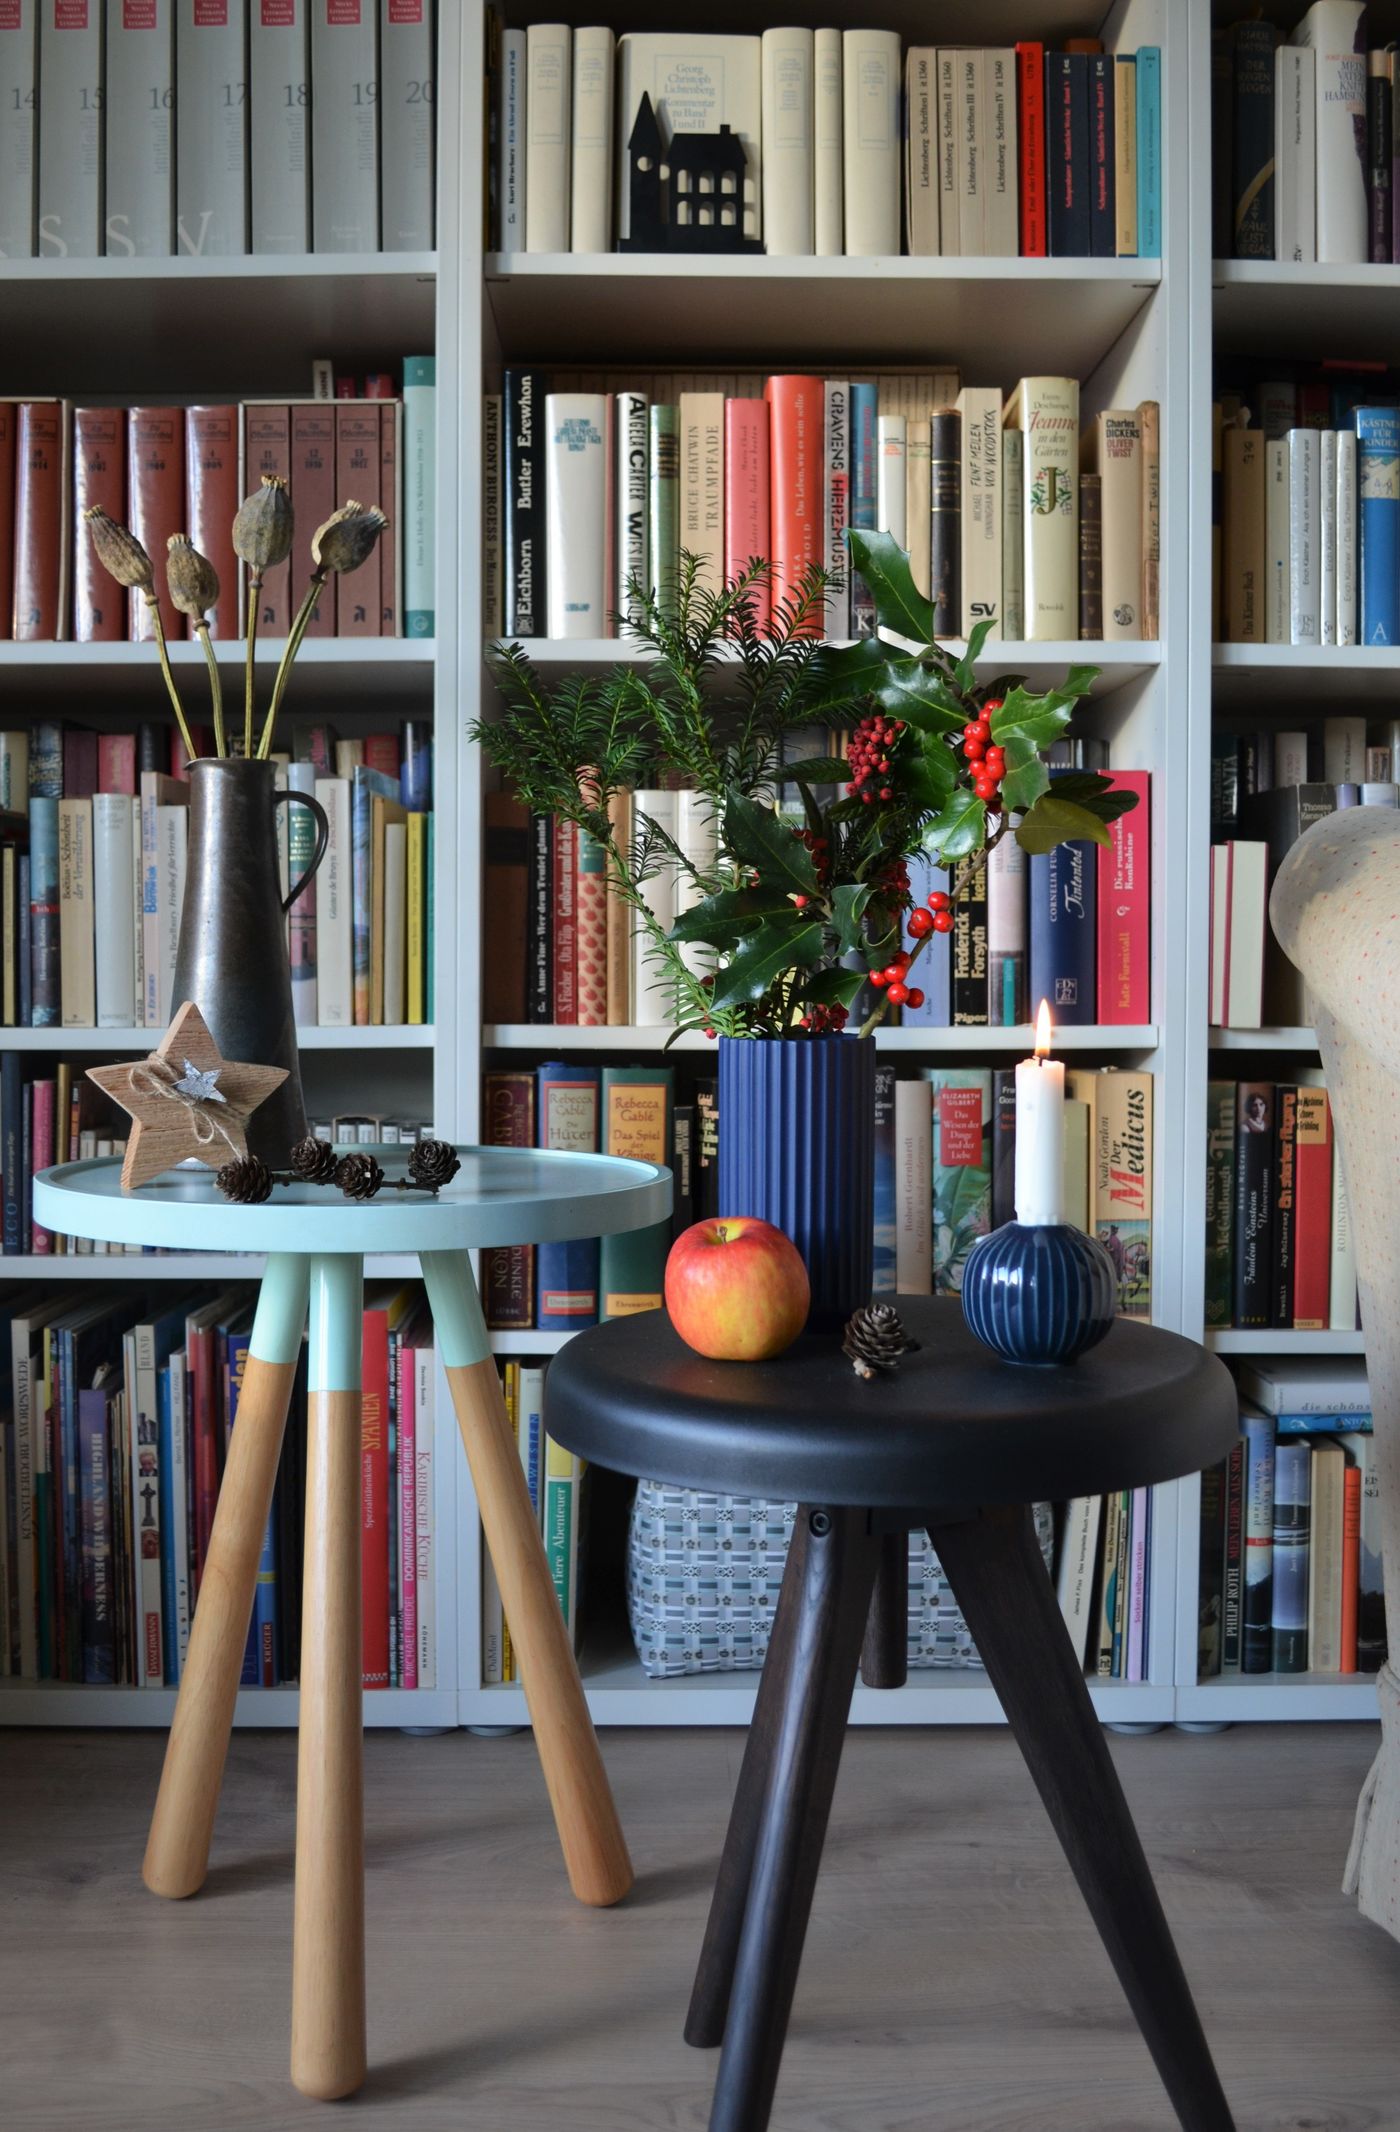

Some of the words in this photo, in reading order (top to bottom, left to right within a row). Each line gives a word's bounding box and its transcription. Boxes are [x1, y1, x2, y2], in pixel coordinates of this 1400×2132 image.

[668, 73, 711, 85] Christoph
[676, 63, 704, 76] Georg
[11, 87, 37, 110] 14
[79, 87, 104, 110] 15
[150, 87, 175, 110] 16
[222, 83, 249, 106] 17
[283, 84, 310, 107] 18
[352, 82, 378, 105] 19
[406, 81, 433, 104] 20
[664, 83, 716, 96] Lichtenberg
[920, 98, 928, 134] Schriften
[944, 100, 952, 138] Schriften
[966, 106, 976, 142] Schriften
[996, 103, 1005, 140] Schriften
[920, 139, 930, 187] Lichtenberg
[944, 142, 954, 191] Lichtenberg
[967, 147, 976, 195] Lichtenberg
[997, 144, 1006, 192] Lichtenberg
[517, 376, 532, 448] Erewhon
[795, 394, 804, 416] sollte
[796, 422, 804, 436] sein
[831, 391, 844, 470] CRAVENS
[1028, 411, 1078, 432] Jeanne
[1106, 419, 1135, 428] Charles
[1106, 428, 1140, 438] DICKENS
[1373, 427, 1392, 438] FÜR
[984, 410, 996, 466] WOODSTOCK
[1034, 445, 1068, 457] Gärten
[1038, 434, 1047, 444] in
[1050, 433, 1066, 444] den
[1106, 440, 1133, 449] OLIVER
[1107, 448, 1132, 458] TWIST
[1364, 438, 1399, 448] KINDER
[687, 426, 698, 484] CHATWIN
[796, 451, 804, 466] wie
[517, 458, 532, 509] Butler
[706, 426, 719, 531] TRAUMPFADE
[796, 468, 805, 497] Leben,
[984, 469, 996, 487] VON
[687, 490, 698, 531] BRUCE
[796, 499, 804, 516] Das
[972, 494, 982, 522] MICHAEL
[831, 479, 844, 594] HERZMUSTER
[517, 538, 532, 615] Eichborn
[970, 603, 996, 616] SV
[1372, 622, 1388, 640] A
[1223, 755, 1238, 824] INFANTA
[1302, 803, 1332, 812] Thomas
[60, 814, 70, 862] Schönheit
[73, 814, 84, 880] Verwilderung
[538, 820, 548, 854] glaubt
[1114, 817, 1122, 868] russische
[538, 856, 546, 890] Teufel
[1122, 832, 1134, 890] Konkubine
[73, 884, 83, 900] der
[1062, 842, 1084, 919] Tintentod
[1114, 871, 1122, 890] Die
[538, 896, 546, 913] dem
[538, 916, 546, 935] Wer
[538, 942, 546, 966] Fine
[954, 913, 969, 979] Frederick
[972, 927, 988, 979] Forsyth
[1119, 932, 1130, 981] Furnivall
[538, 968, 546, 995] Anne
[1119, 985, 1130, 1008] Kate
[954, 1013, 986, 1023] Piper
[550, 1092, 594, 1104] Rebecca
[556, 1104, 586, 1116] Gablé
[615, 1097, 659, 1110] Rebecca
[942, 1092, 980, 1100] ELIZABETH
[620, 1109, 655, 1122] Gablé
[944, 1120, 966, 1129] Wesen
[967, 1120, 979, 1128] der
[954, 1110, 968, 1119] Das
[1207, 1098, 1234, 1160] Tim
[550, 1127, 594, 1140] Hüter
[614, 1129, 632, 1140] Das
[636, 1129, 660, 1142] Spiel
[630, 1140, 644, 1148] der
[948, 1141, 962, 1149] und
[962, 1140, 974, 1149] der
[950, 1131, 972, 1140] Dinge
[1098, 1116, 1109, 1159] Gordon
[904, 1136, 913, 1192] Gernhardt
[916, 1136, 926, 1184] anderswo
[952, 1150, 971, 1160] Liebe
[1108, 1089, 1144, 1211] Medicus
[1110, 1140, 1121, 1164] Der
[1098, 1162, 1109, 1190] Noah
[916, 1186, 926, 1206] und
[1216, 1165, 1232, 1256] McCullough
[1256, 1168, 1268, 1229] Universum
[904, 1196, 913, 1232] Robert
[916, 1209, 926, 1238] Glück
[1244, 1190, 1258, 1240] Einsteins
[1280, 1211, 1291, 1253] McInerney
[511, 1246, 522, 1300] DUNKLE
[1244, 1242, 1256, 1286] Fräulein
[1280, 1253, 1288, 1268] Jay
[16, 1356, 28, 1437] WORPSWEDE
[1302, 1402, 1320, 1411] die
[1327, 1402, 1371, 1411] schöns
[361, 1392, 381, 1450] SPANIEN
[91, 1433, 105, 1516] HIGHLAND
[403, 1436, 414, 1486] REPUBLIK
[20, 1442, 32, 1540] KÜNSTLERDORF
[364, 1454, 374, 1529] Spezialitätenküche
[418, 1451, 431, 1529] KARIBISCHE
[1228, 1474, 1241, 1493] ALS
[1254, 1462, 1262, 1526] Schneeland
[552, 1488, 566, 1549] Abenteuer
[1227, 1498, 1240, 1530] LEBEN
[404, 1489, 414, 1582] DOMINIKANISCHE
[1228, 1534, 1240, 1560] MEIN
[93, 1520, 106, 1621] WILDERNESS
[418, 1534, 431, 1580] KÜCHE
[1226, 1568, 1240, 1599] ROTH
[404, 1596, 414, 1631] FRIEDEL
[1226, 1601, 1240, 1637] PHILIP
[264, 1624, 272, 1662] KRÜGER
[404, 1632, 415, 1676] MICHAEL
